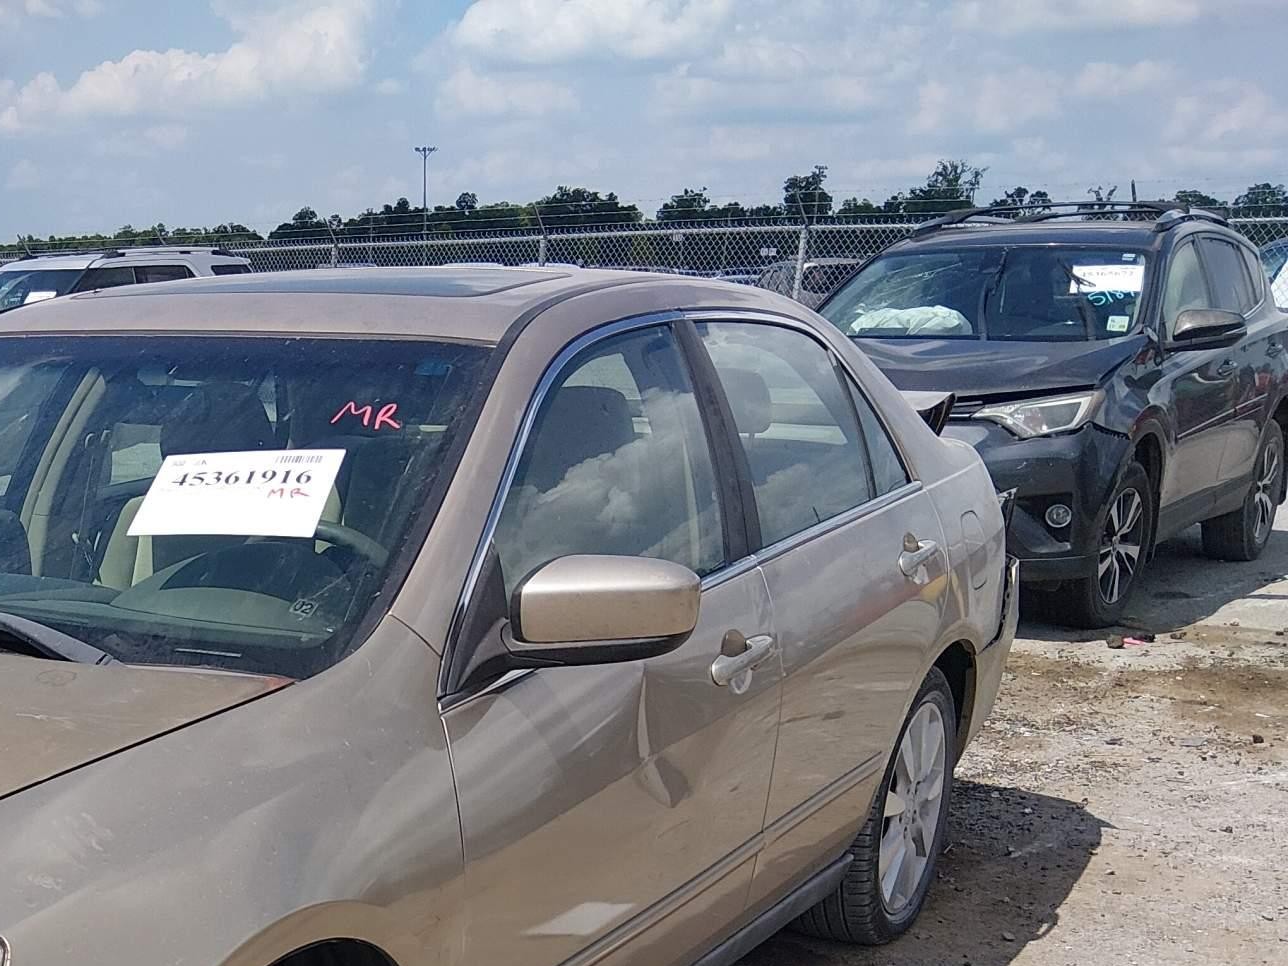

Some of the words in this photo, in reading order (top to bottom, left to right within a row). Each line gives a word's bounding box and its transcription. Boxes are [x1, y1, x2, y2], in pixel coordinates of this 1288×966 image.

[330, 401, 400, 430] MR
[171, 469, 313, 487] 45361916
[294, 600, 314, 615] 02
